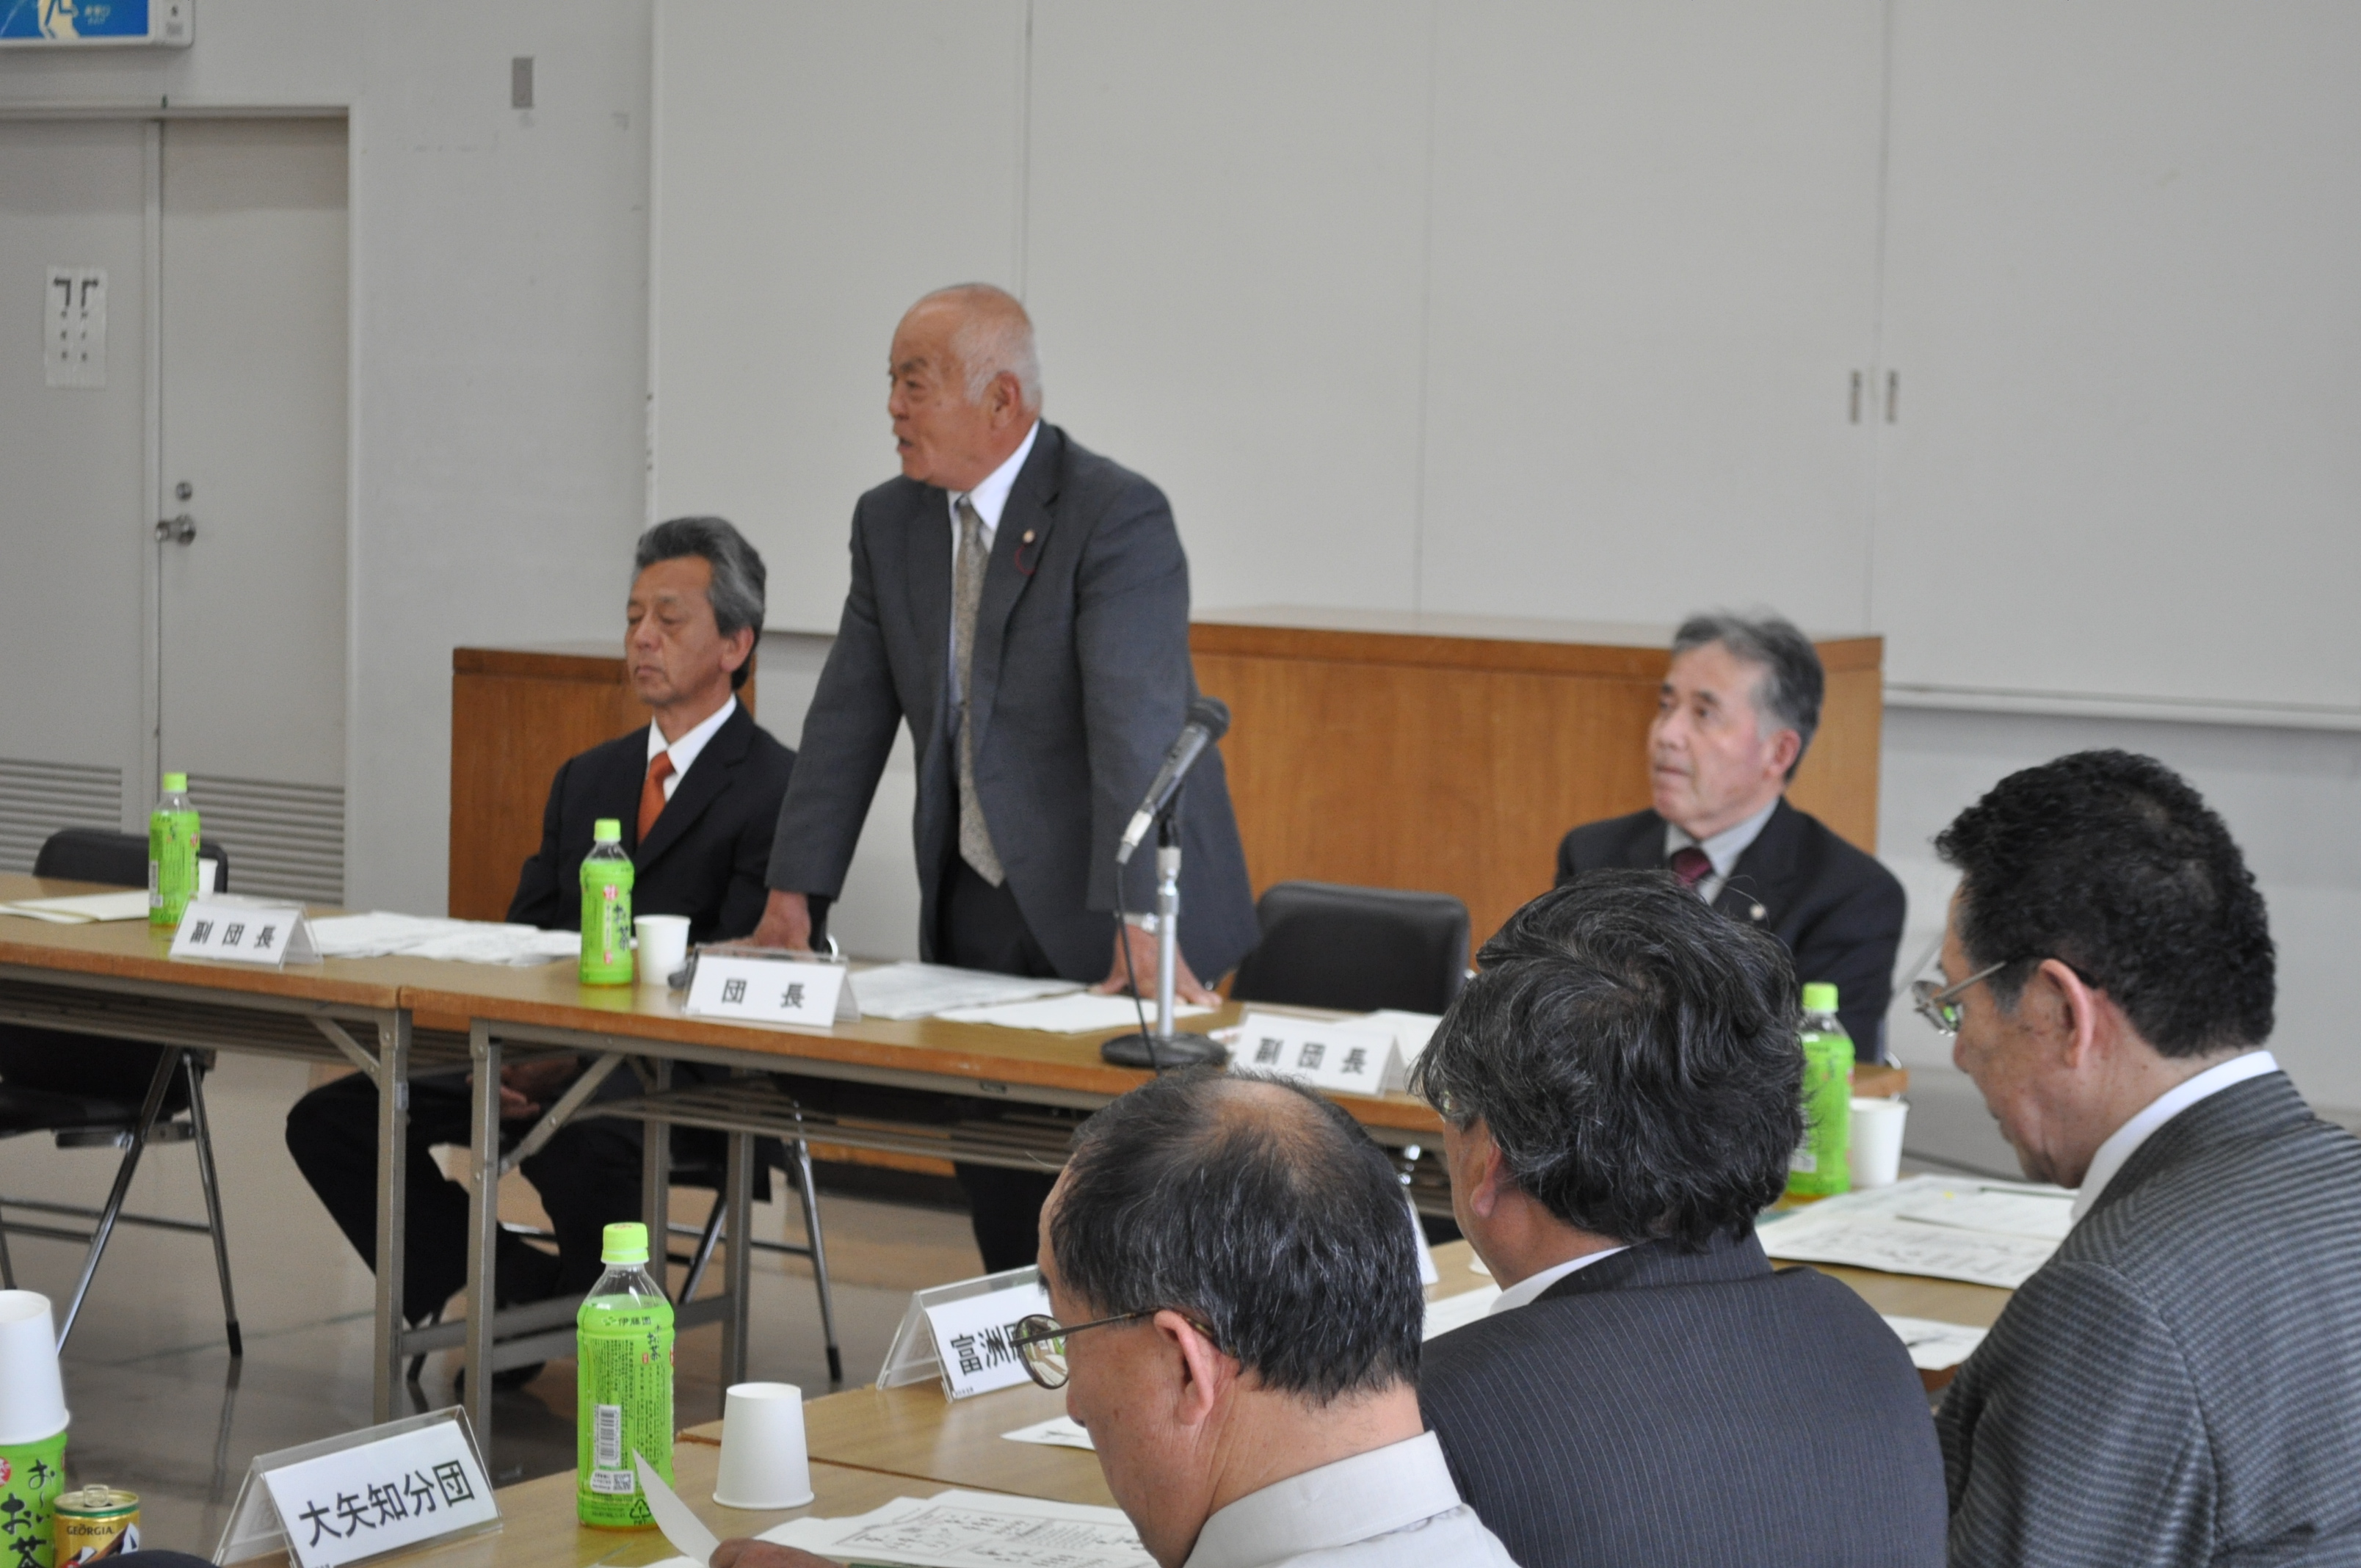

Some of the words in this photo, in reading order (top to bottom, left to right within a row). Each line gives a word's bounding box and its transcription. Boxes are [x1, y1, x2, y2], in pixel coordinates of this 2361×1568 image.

[189, 920, 275, 948] 副団長
[721, 978, 805, 1009] 団長
[1255, 1038, 1366, 1073] 副団長
[298, 1459, 476, 1548] 大矢知分団
